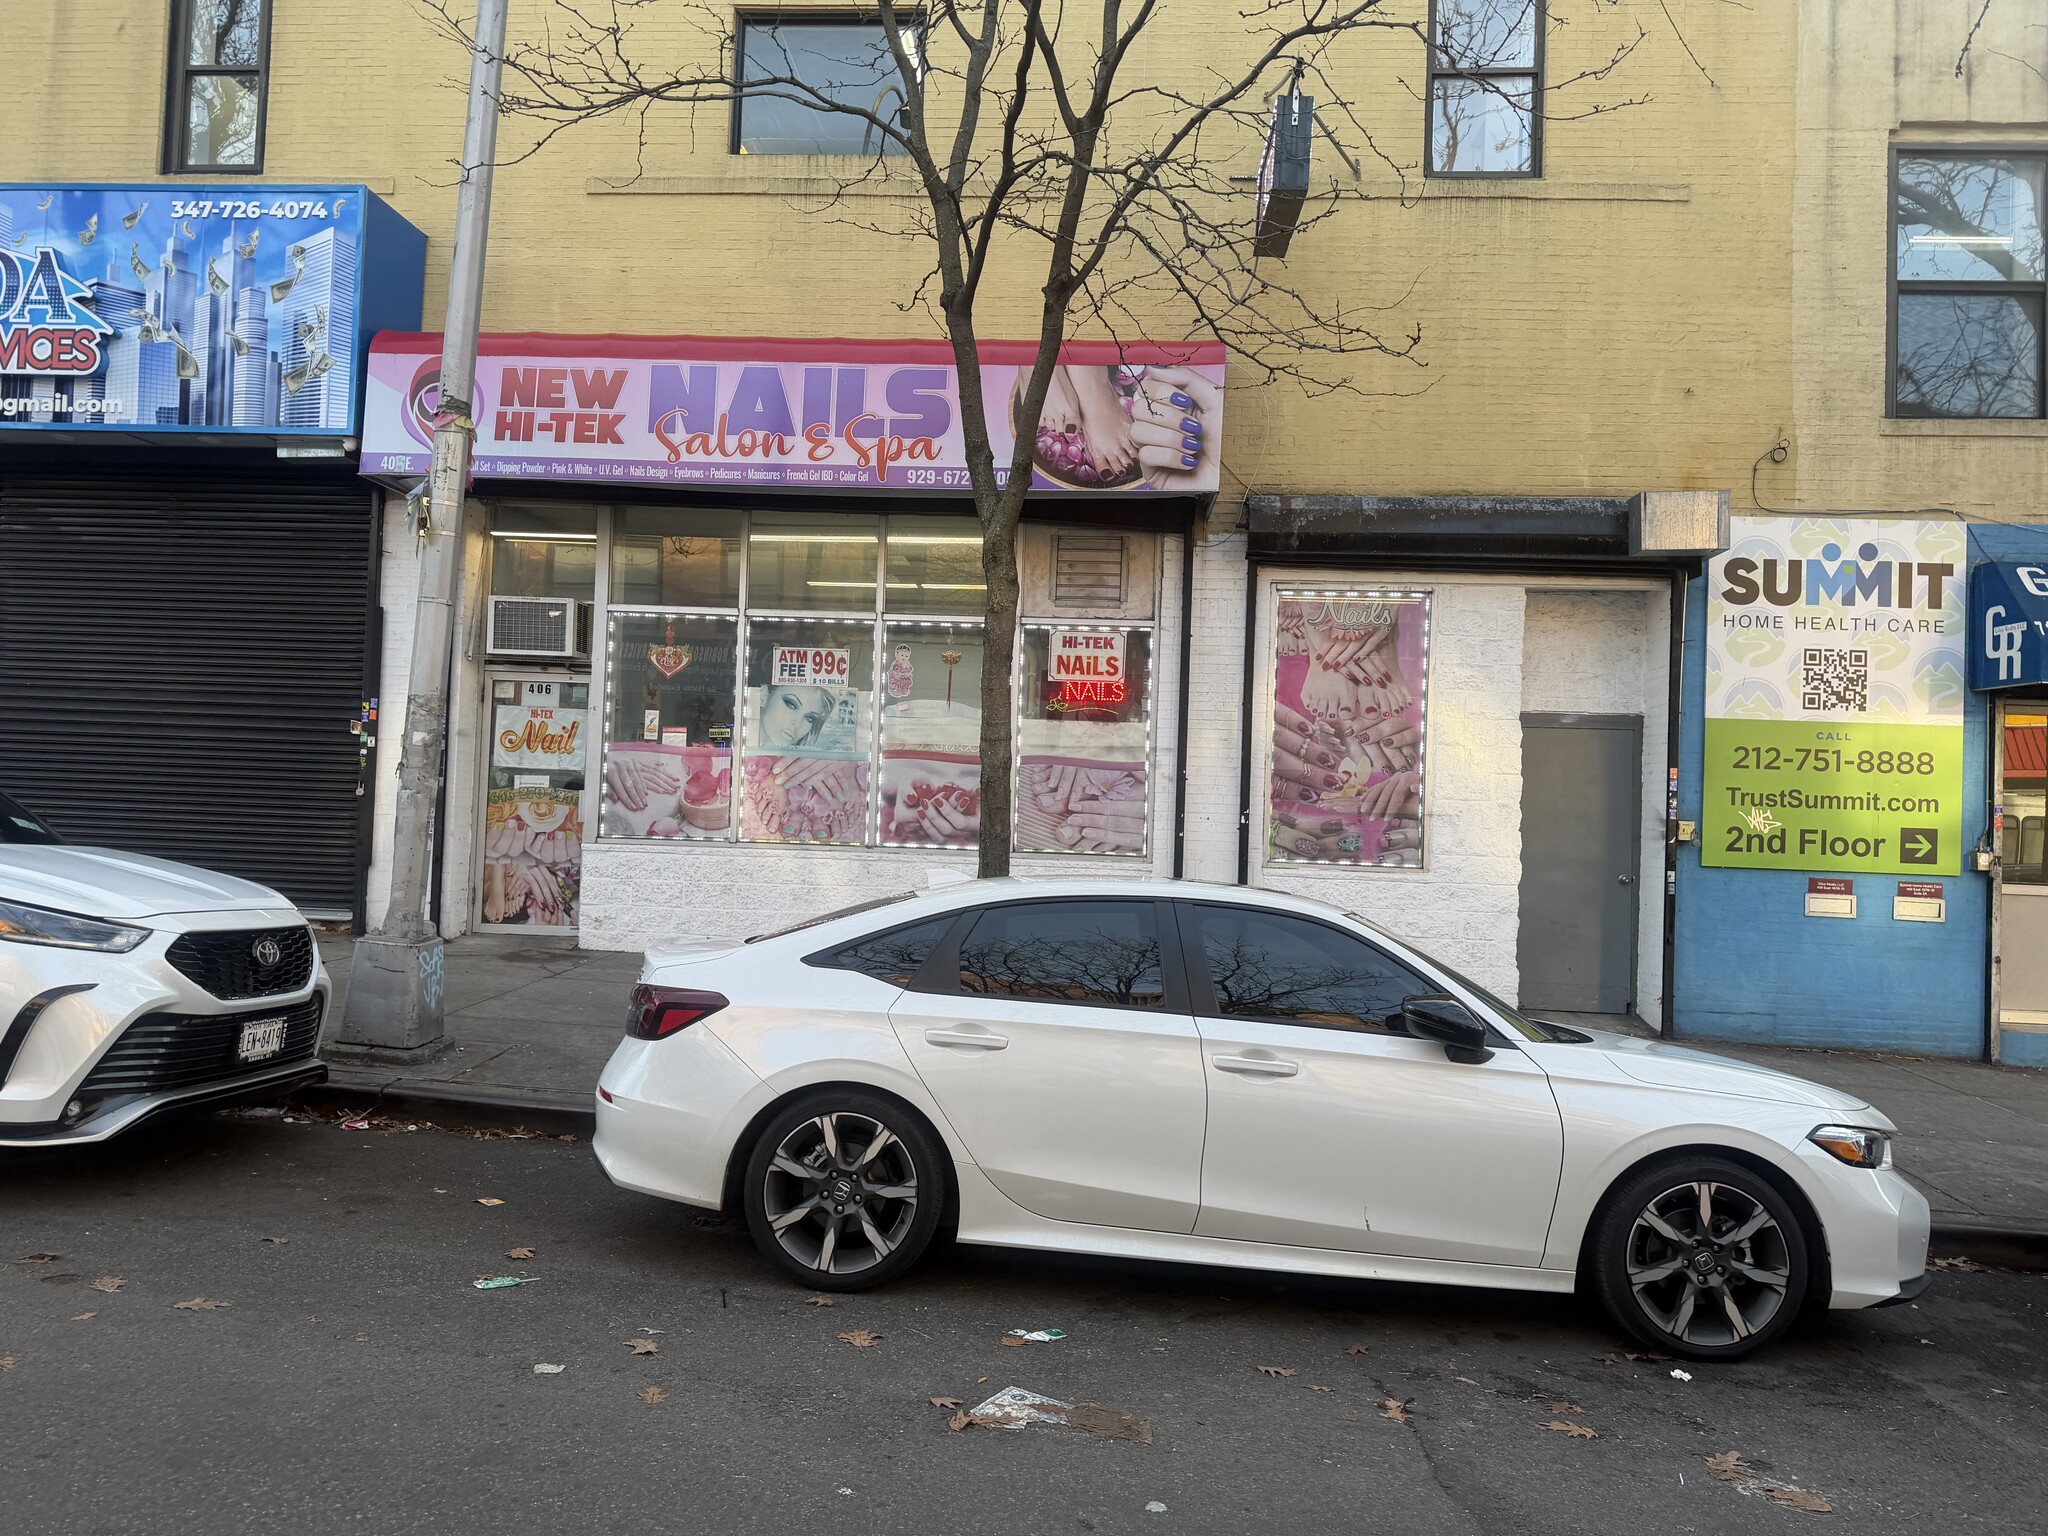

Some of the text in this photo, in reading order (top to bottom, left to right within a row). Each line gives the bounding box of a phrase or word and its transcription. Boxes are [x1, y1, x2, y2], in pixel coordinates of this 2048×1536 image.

[170, 200, 328, 220] 347-726-4074
[500, 366, 630, 410] NEW
[0, 393, 123, 416] gmail.com
[648, 363, 952, 441] NAILS
[494, 411, 626, 444] HI-TEK
[655, 408, 798, 463] Salon
[844, 413, 942, 483] Spa
[381, 456, 405, 471] 40
[479, 460, 491, 472] Set
[497, 461, 522, 475] Dipping
[522, 461, 545, 473] Powder
[552, 461, 567, 474] Pink
[567, 462, 573, 474] &
[574, 462, 592, 474] White
[598, 464, 611, 476] U.V.
[612, 465, 624, 476] Gel
[629, 465, 646, 477] Nails
[647, 466, 668, 479] Design
[674, 467, 704, 479] Eyebrows
[710, 467, 742, 480] Pedicures
[747, 468, 780, 480] Manicures
[786, 469, 807, 480] French
[808, 469, 821, 481] Gel
[821, 470, 833, 481] IBD
[839, 470, 857, 482] Color
[858, 471, 869, 482] Gel
[1721, 557, 1954, 610] SUMMIT
[1308, 598, 1393, 627] Nails
[1723, 614, 1945, 634] HOME HEALTH CARE
[1062, 635, 1115, 650] HI-TEK
[779, 650, 807, 663] ATM
[812, 650, 847, 678] 99¢
[780, 664, 806, 677] FEE
[528, 684, 552, 694] 406
[1066, 681, 1124, 702] NAILS
[500, 720, 580, 755] Nail
[1816, 731, 1851, 741] CALL
[1732, 746, 1935, 776] 212-751-8888
[1725, 787, 1939, 814] TrustSummit.com
[1725, 826, 1786, 855] 2nd
[1799, 829, 1886, 858] Floor
